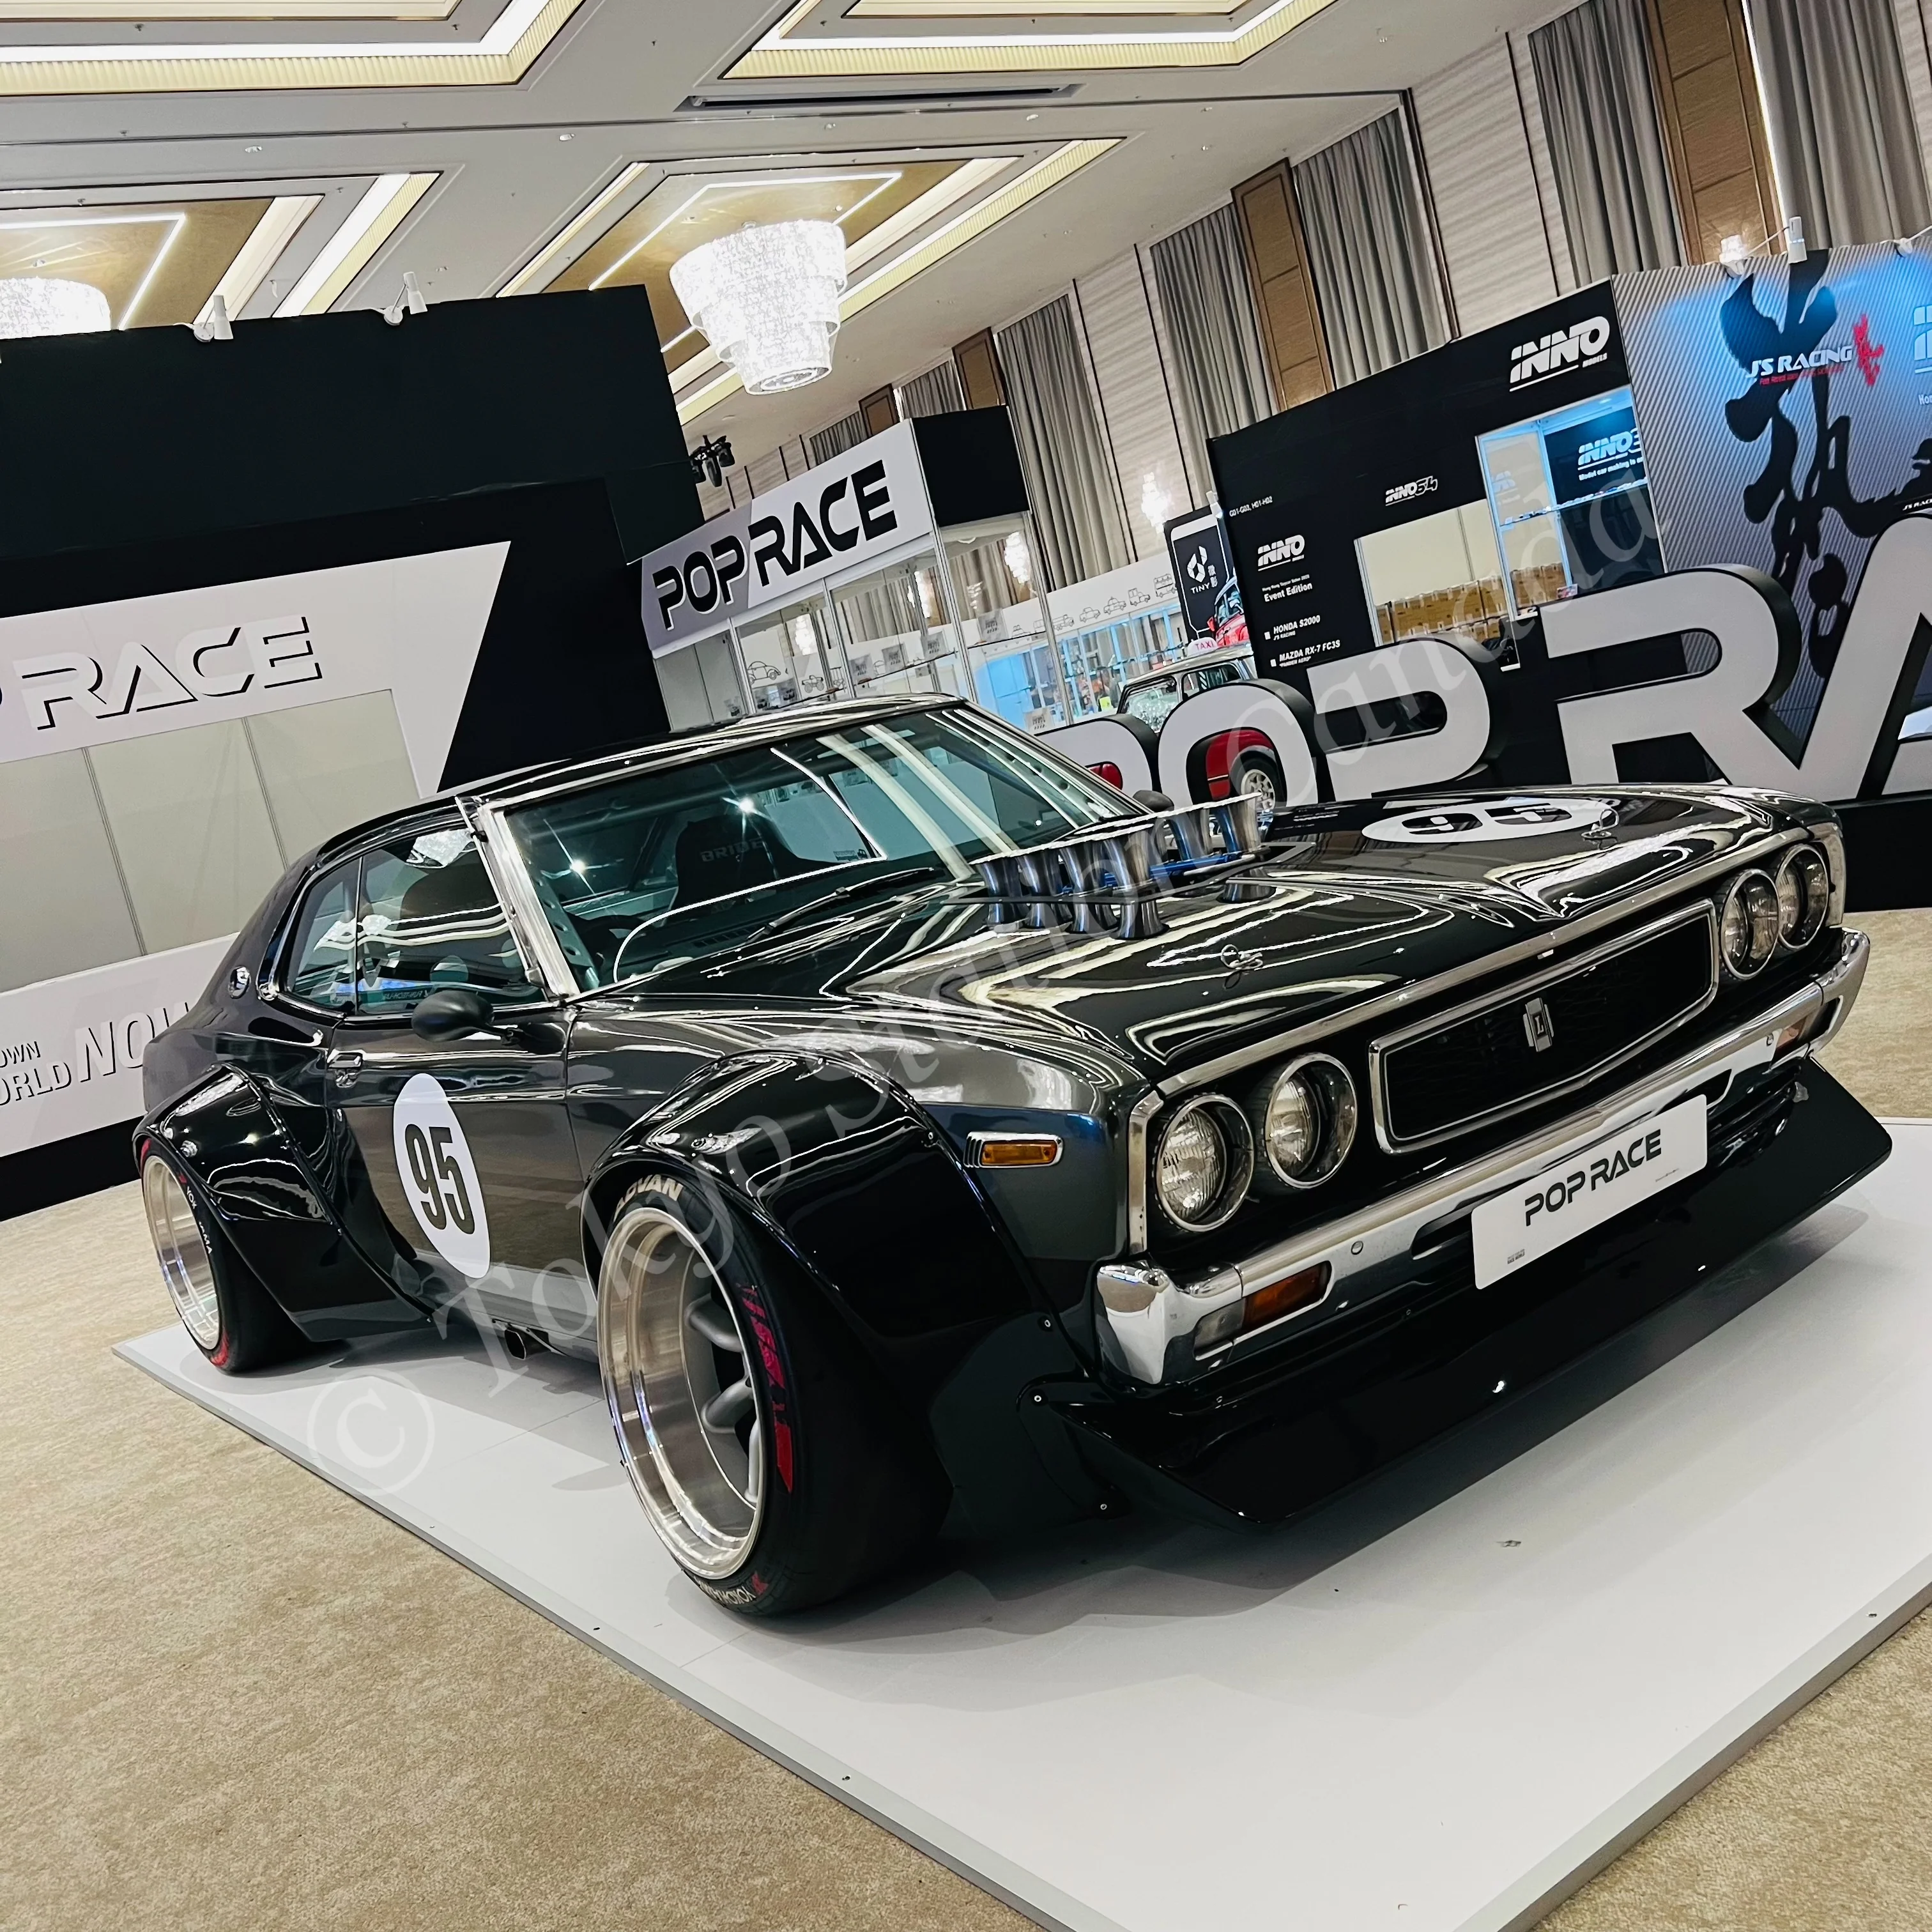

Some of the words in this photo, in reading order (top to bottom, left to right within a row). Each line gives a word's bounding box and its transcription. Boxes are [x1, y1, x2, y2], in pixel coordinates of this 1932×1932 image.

[1510, 316, 1610, 383] INNO
[1745, 358, 1774, 378] J'S
[1777, 345, 1852, 373] RACING
[652, 535, 748, 631] POP
[747, 459, 898, 586] RACE
[1257, 534, 1305, 567] INNO
[1190, 582, 1210, 594] TINY
[1264, 590, 1285, 602] Event
[1285, 583, 1313, 597] Edition
[1273, 621, 1298, 634] HONDA
[1299, 615, 1321, 627] S2000
[1195, 640, 1214, 652] TAXI
[1279, 648, 1303, 662] MAZDA
[1305, 644, 1321, 656] RX-7
[1322, 639, 1340, 651] FC3S
[13, 613, 323, 730] RACE
[405, 1124, 475, 1234] 95
[1524, 1170, 1586, 1227] POP
[1590, 1128, 1661, 1192] RACE
[613, 1174, 684, 1223] ADVAN
